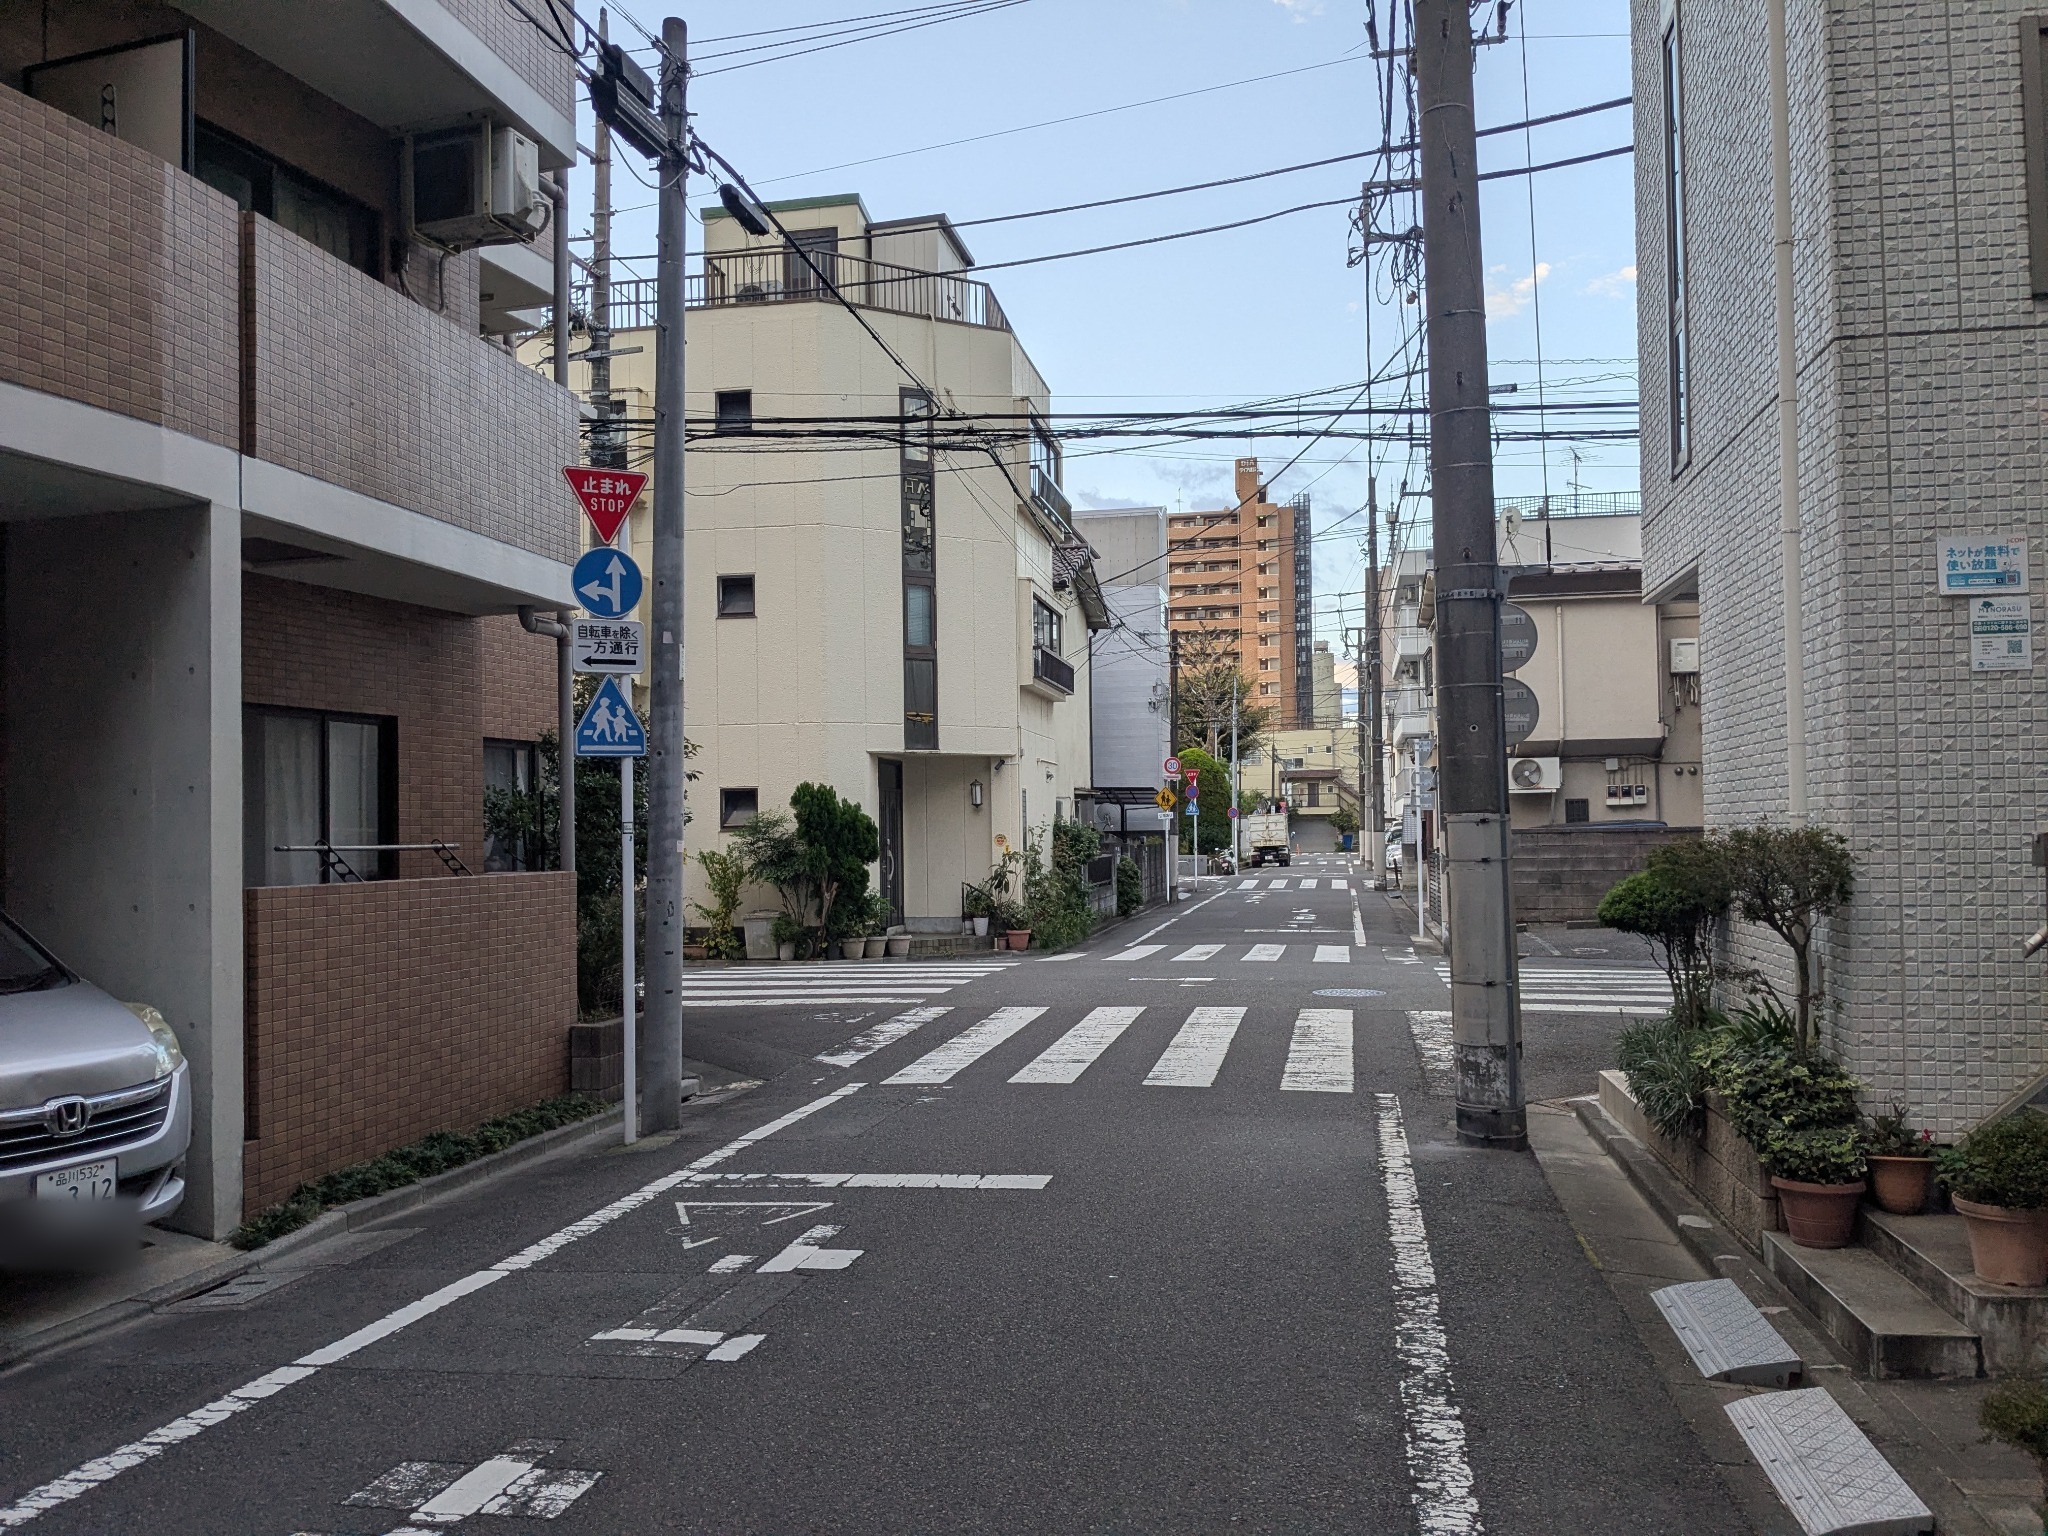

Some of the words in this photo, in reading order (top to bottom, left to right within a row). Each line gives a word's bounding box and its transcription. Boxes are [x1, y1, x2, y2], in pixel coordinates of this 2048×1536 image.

[581, 476, 632, 496] 止まれ
[590, 497, 625, 513] STOP
[1946, 545, 2020, 558] ネットが無料で
[1946, 558, 1998, 571] 使い放題
[578, 624, 638, 640] 自転車を除く
[578, 641, 639, 655] 一方通行
[1167, 761, 1178, 770] 30
